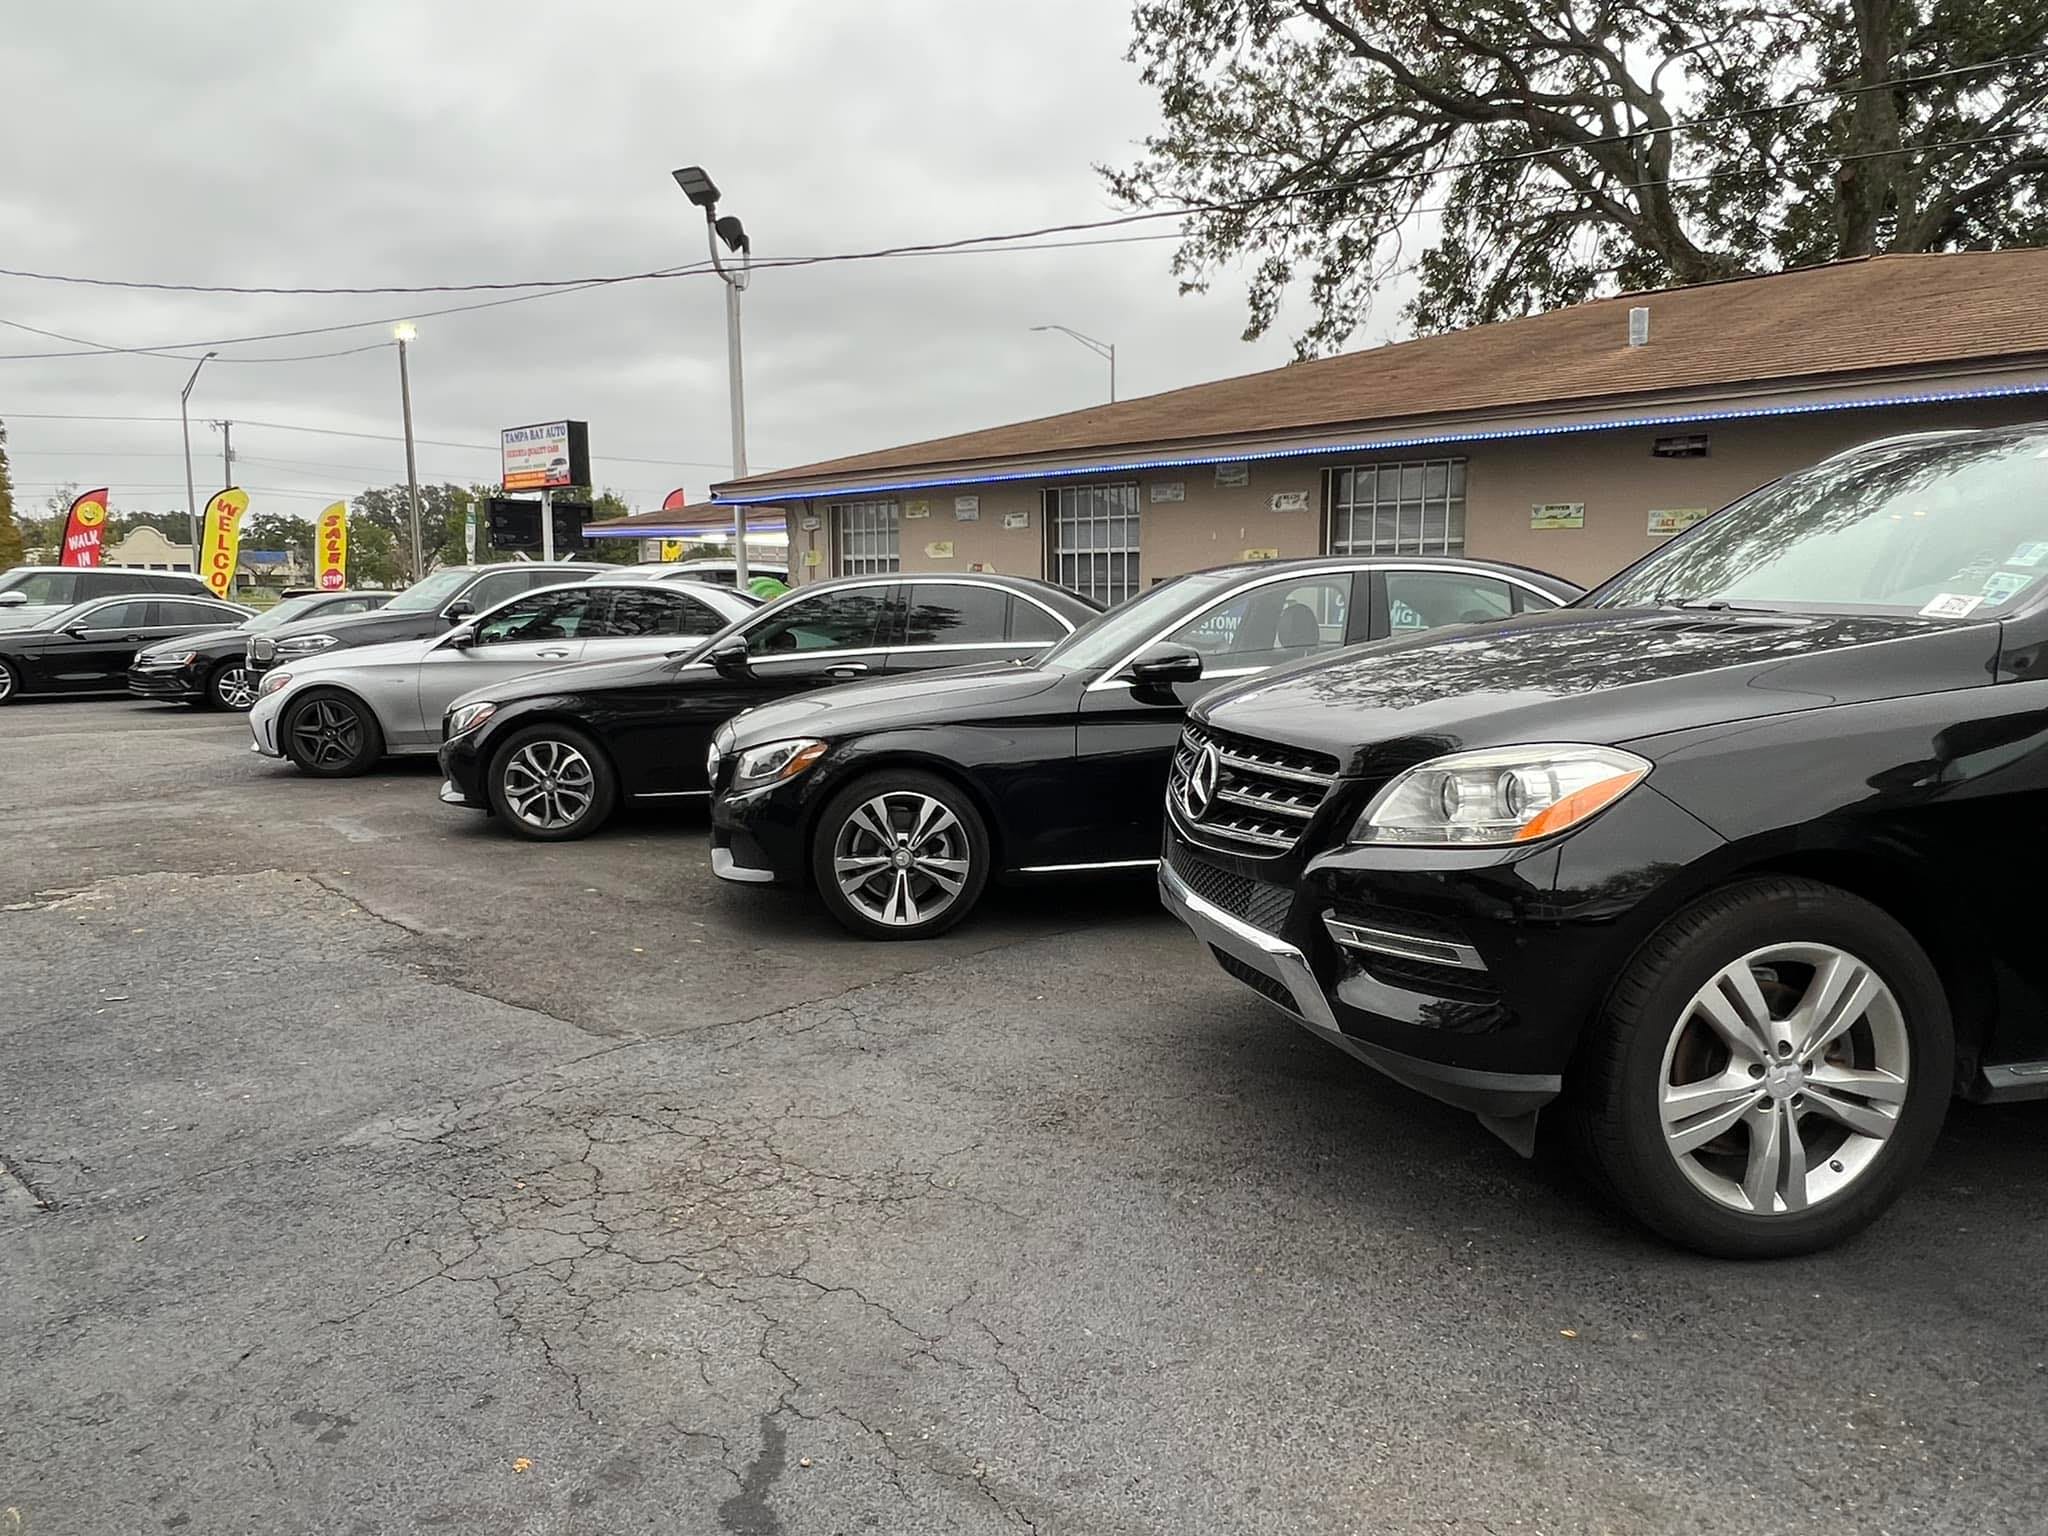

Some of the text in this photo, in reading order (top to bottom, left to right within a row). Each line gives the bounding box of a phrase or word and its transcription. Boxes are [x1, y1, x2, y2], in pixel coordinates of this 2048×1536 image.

[505, 425, 566, 443] TAMPA BAY AUTO
[68, 530, 100, 551] WALK
[212, 498, 240, 596] WELCO
[77, 551, 91, 567] IN
[322, 575, 343, 586] STOP
